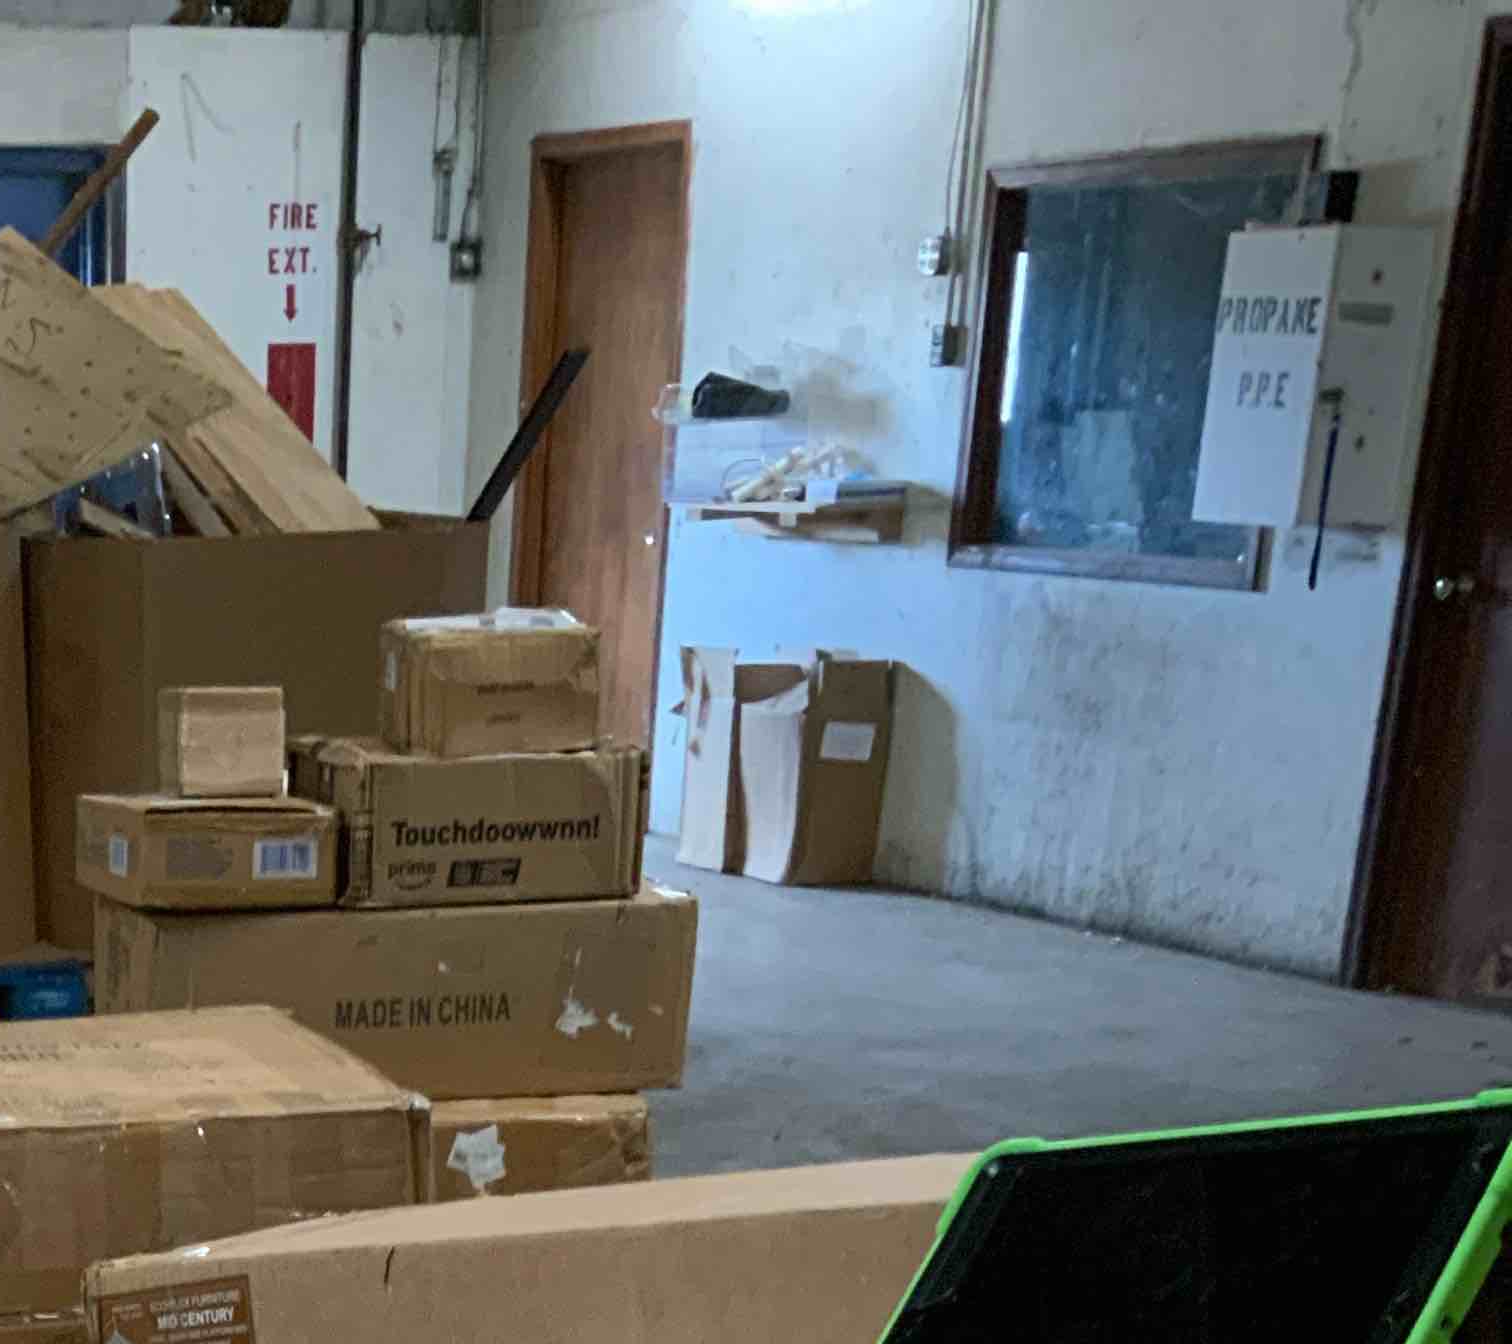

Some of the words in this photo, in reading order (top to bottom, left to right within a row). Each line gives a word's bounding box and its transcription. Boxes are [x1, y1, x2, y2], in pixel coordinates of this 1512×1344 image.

[269, 203, 318, 229] FIRE
[268, 247, 317, 273] EXT.
[1217, 297, 1322, 334] PROPANE
[391, 815, 600, 847] Touchdoowwnn!
[335, 999, 403, 1028] MADE
[409, 997, 431, 1028] IN
[438, 992, 510, 1024] CHINA
[180, 1307, 235, 1328] CENTURY
